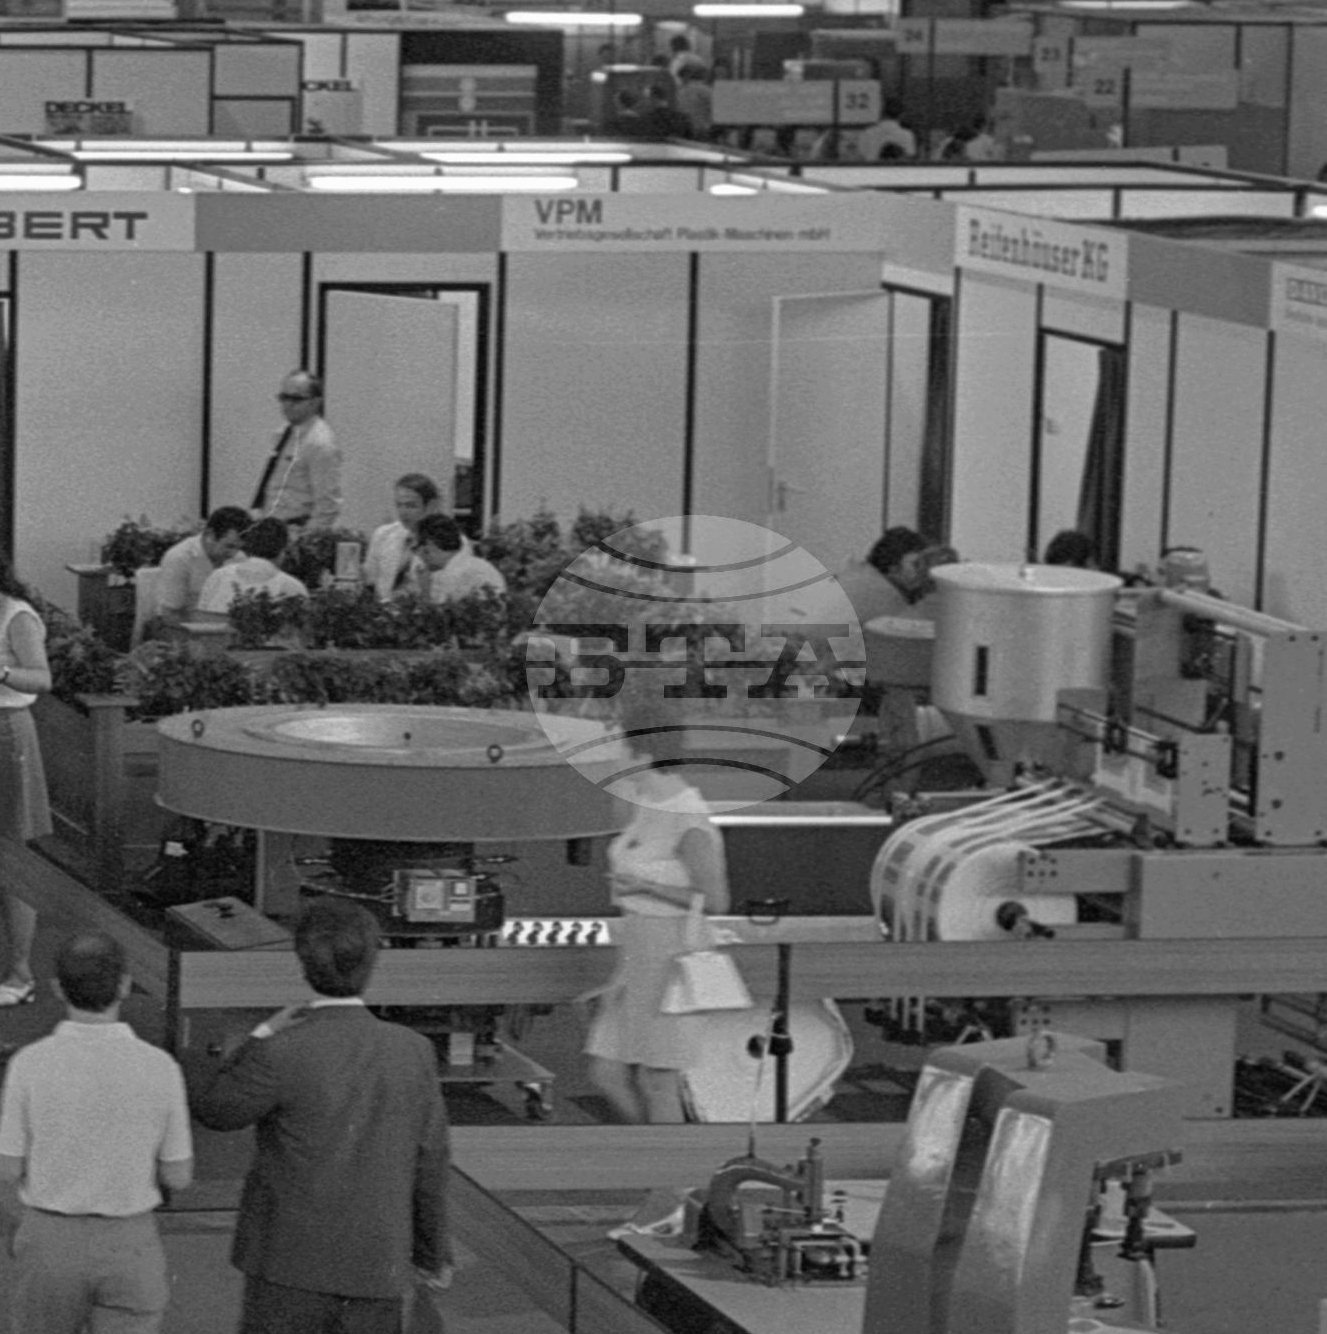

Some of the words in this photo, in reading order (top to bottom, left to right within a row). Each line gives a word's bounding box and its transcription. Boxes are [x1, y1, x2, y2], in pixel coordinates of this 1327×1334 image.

[45, 101, 133, 114] DECKEL
[534, 199, 603, 224] VPM
[1081, 238, 1109, 283] KG
